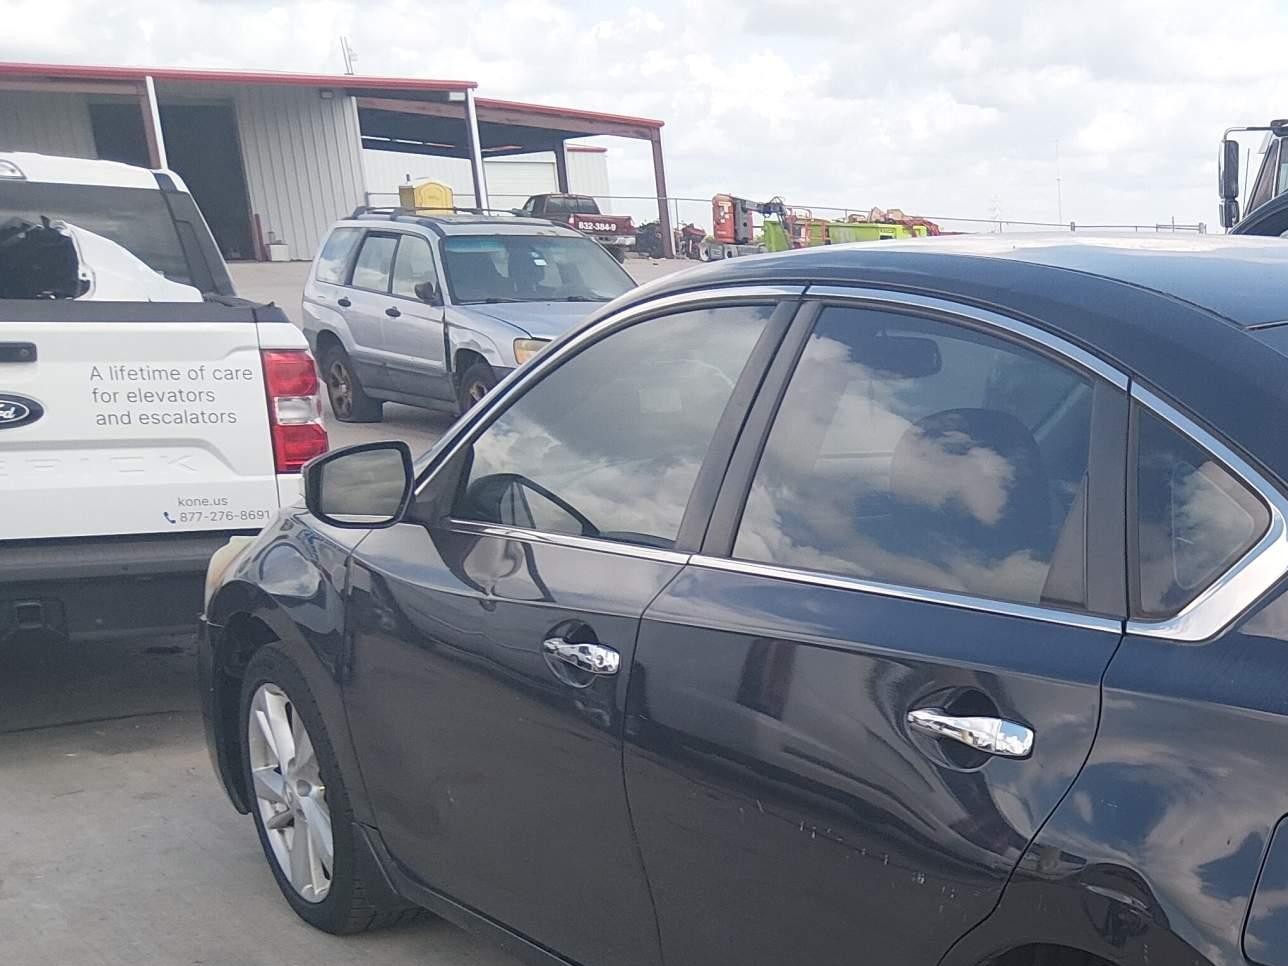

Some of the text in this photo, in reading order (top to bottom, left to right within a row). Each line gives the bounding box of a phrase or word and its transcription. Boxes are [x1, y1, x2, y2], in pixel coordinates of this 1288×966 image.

[90, 365, 253, 381] A lifetime of care
[92, 387, 216, 404] for elevators
[96, 409, 237, 426] and escalators
[178, 496, 228, 507] kone.us
[180, 509, 271, 522] 877-276-8691
